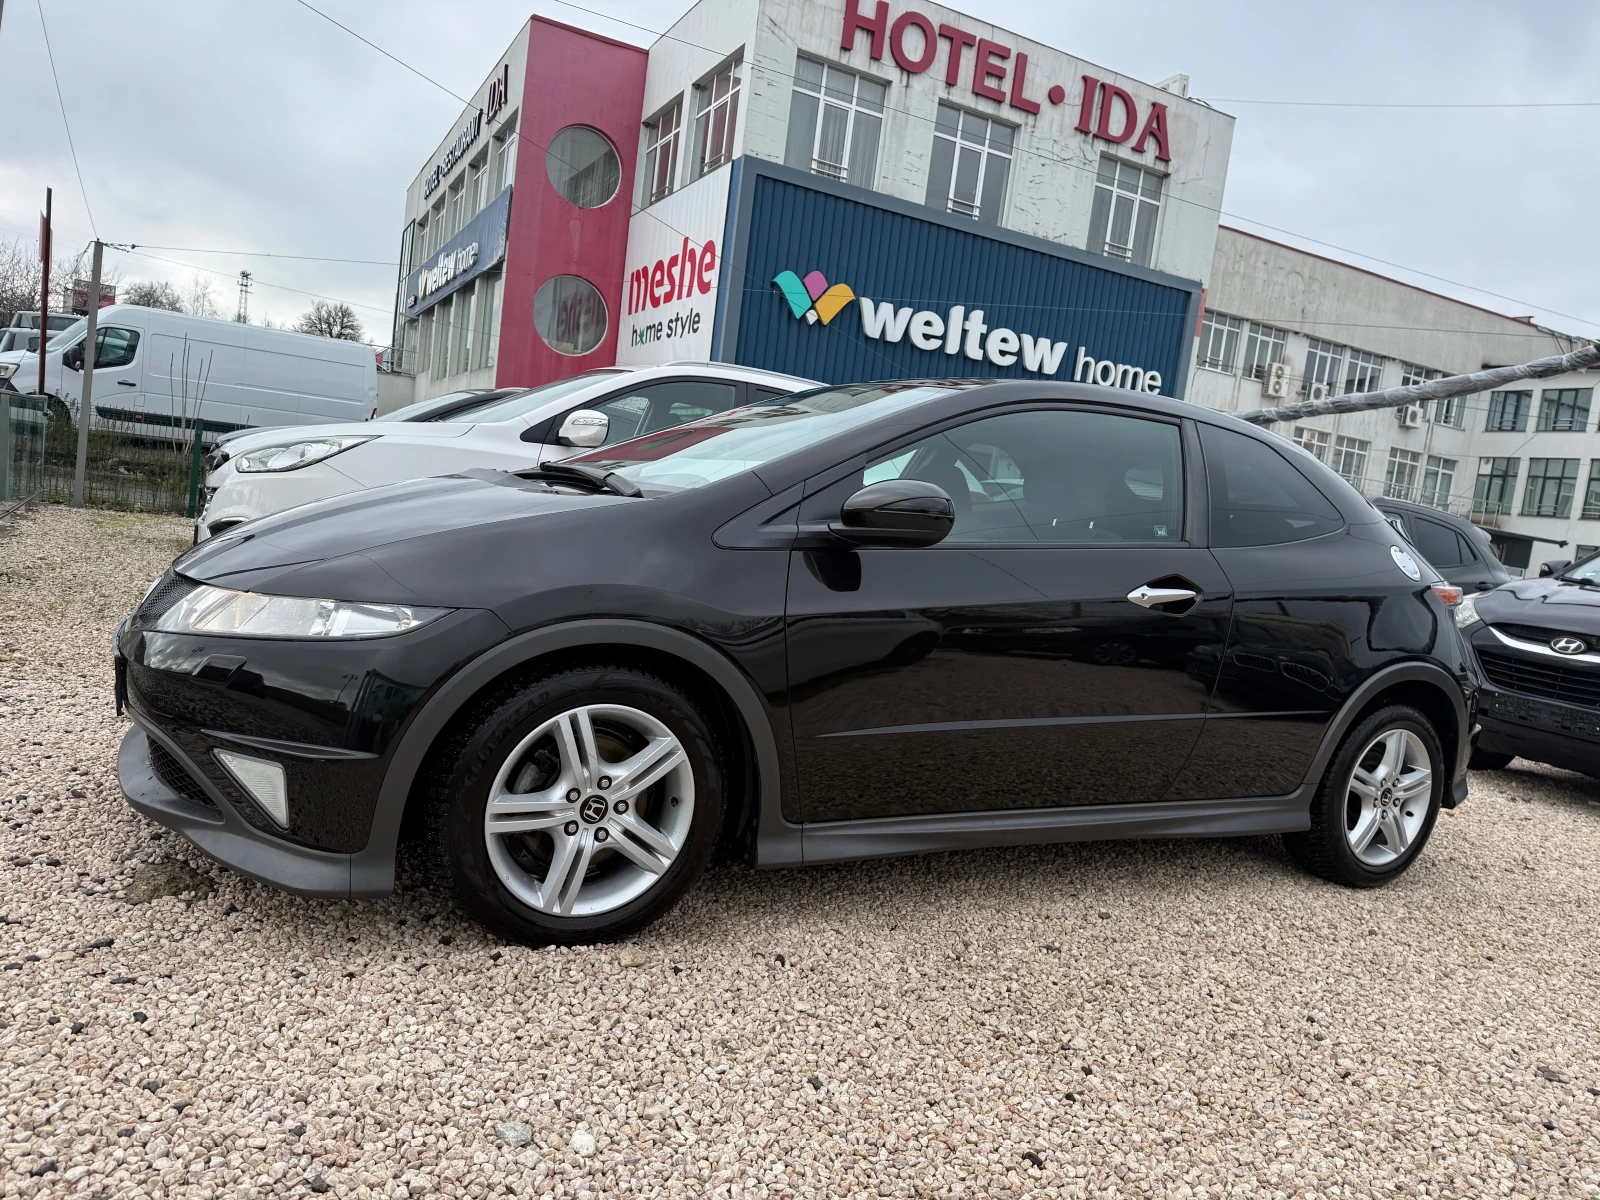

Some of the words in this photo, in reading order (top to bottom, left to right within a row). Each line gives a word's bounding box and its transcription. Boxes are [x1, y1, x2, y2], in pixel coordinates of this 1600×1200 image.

[840, 0, 1041, 115] HOTEL
[1074, 74, 1172, 162] IDA
[627, 236, 716, 315] meshe
[666, 308, 700, 339] style
[859, 296, 1068, 375] weltew
[1073, 346, 1162, 395] home
